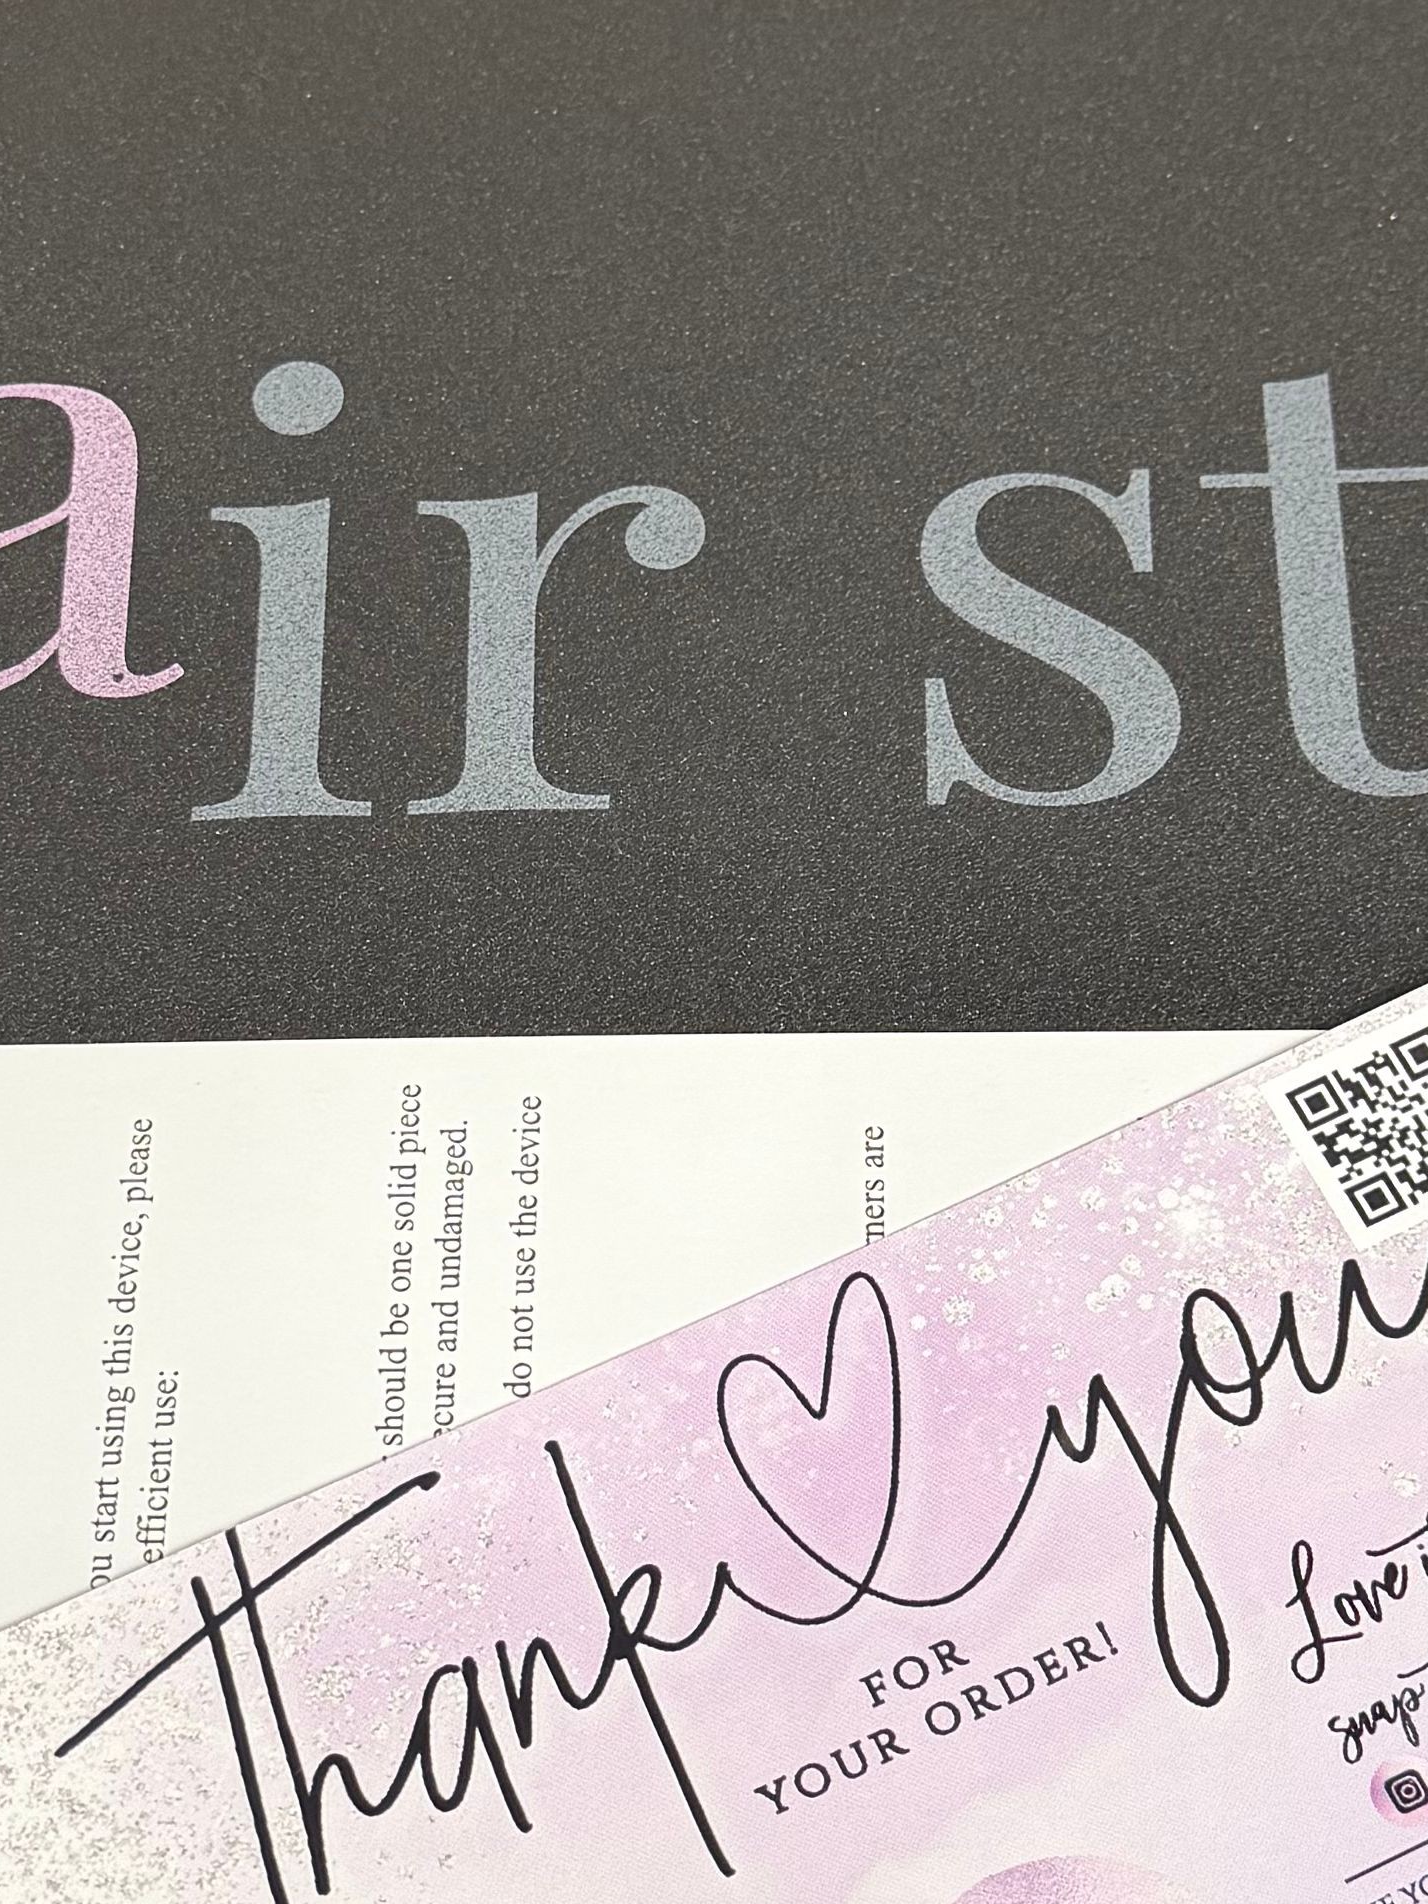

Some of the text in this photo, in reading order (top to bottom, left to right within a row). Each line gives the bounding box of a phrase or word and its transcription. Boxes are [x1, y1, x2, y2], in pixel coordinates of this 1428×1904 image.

[118, 1118, 154, 1203] please
[864, 1125, 885, 1169] are
[433, 1120, 474, 1291] undamaged.
[502, 1095, 542, 1399] do not use the device
[107, 1213, 150, 1314] device,
[374, 1084, 427, 1447] should be one solid piece
[101, 1323, 134, 1377] this
[430, 1299, 460, 1353] and
[94, 1385, 136, 1468] using
[134, 1370, 180, 1565] efficient use:
[90, 1476, 120, 1543] start
[1285, 1539, 1408, 1684] Love
[859, 1639, 969, 1708] FOR
[754, 1620, 1121, 1815] YOUR ORDER!
[1327, 1682, 1426, 1764] snap
